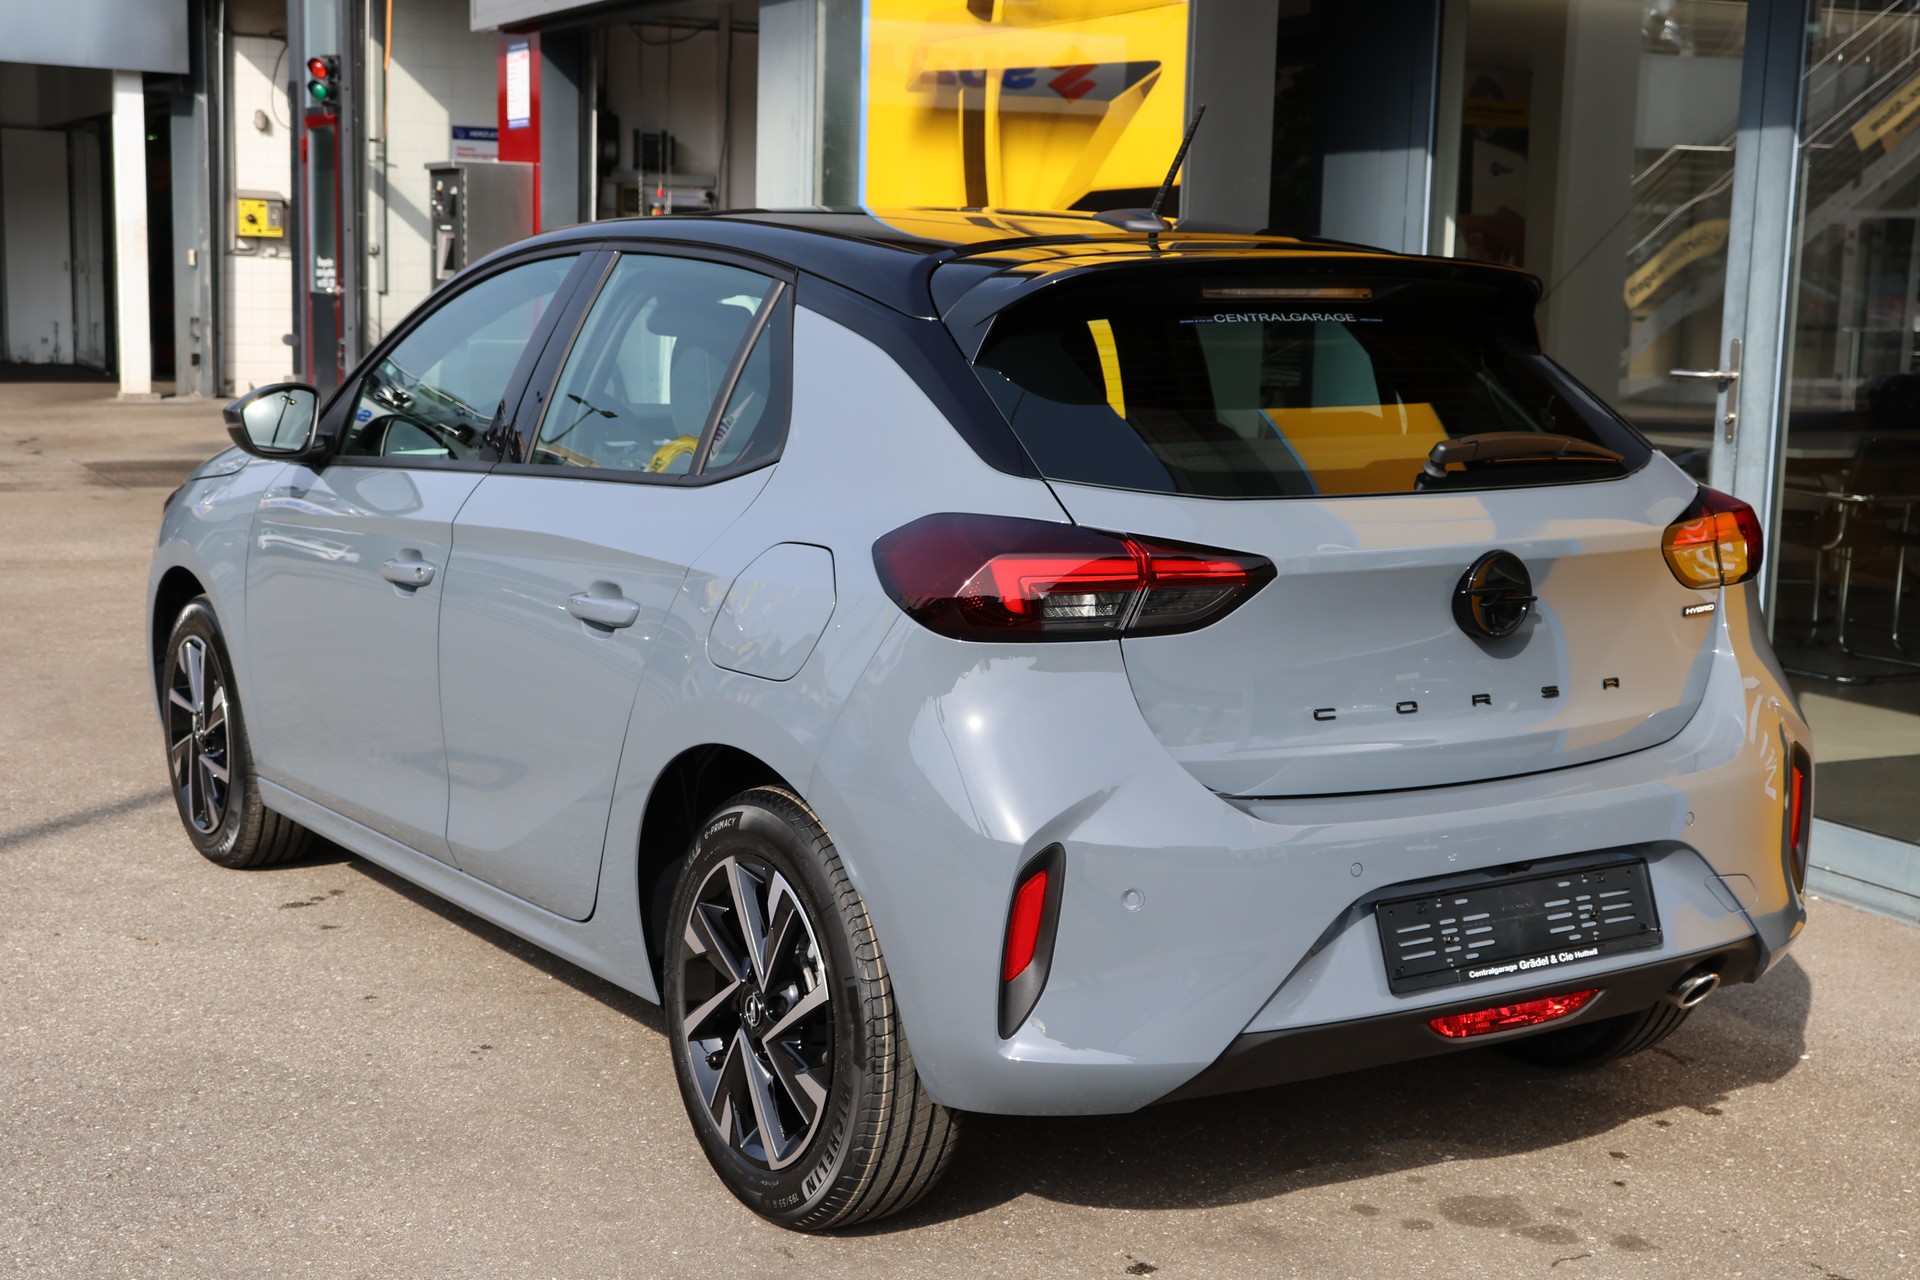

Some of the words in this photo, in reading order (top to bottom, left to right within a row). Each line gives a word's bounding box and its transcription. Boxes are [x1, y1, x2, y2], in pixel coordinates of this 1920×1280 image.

[1213, 313, 1356, 323] CENTRALGARAGE
[1685, 604, 1715, 615] HYBRID
[1314, 677, 1619, 721] CORSA
[704, 817, 736, 840] e-PRIMACY
[1469, 964, 1518, 978] Centralgarage
[1519, 956, 1549, 970] Grädel
[1550, 955, 1558, 964] &
[1558, 951, 1574, 962] Cie
[1574, 948, 1598, 960] Huttwil
[805, 1079, 851, 1195] MICHELIN
